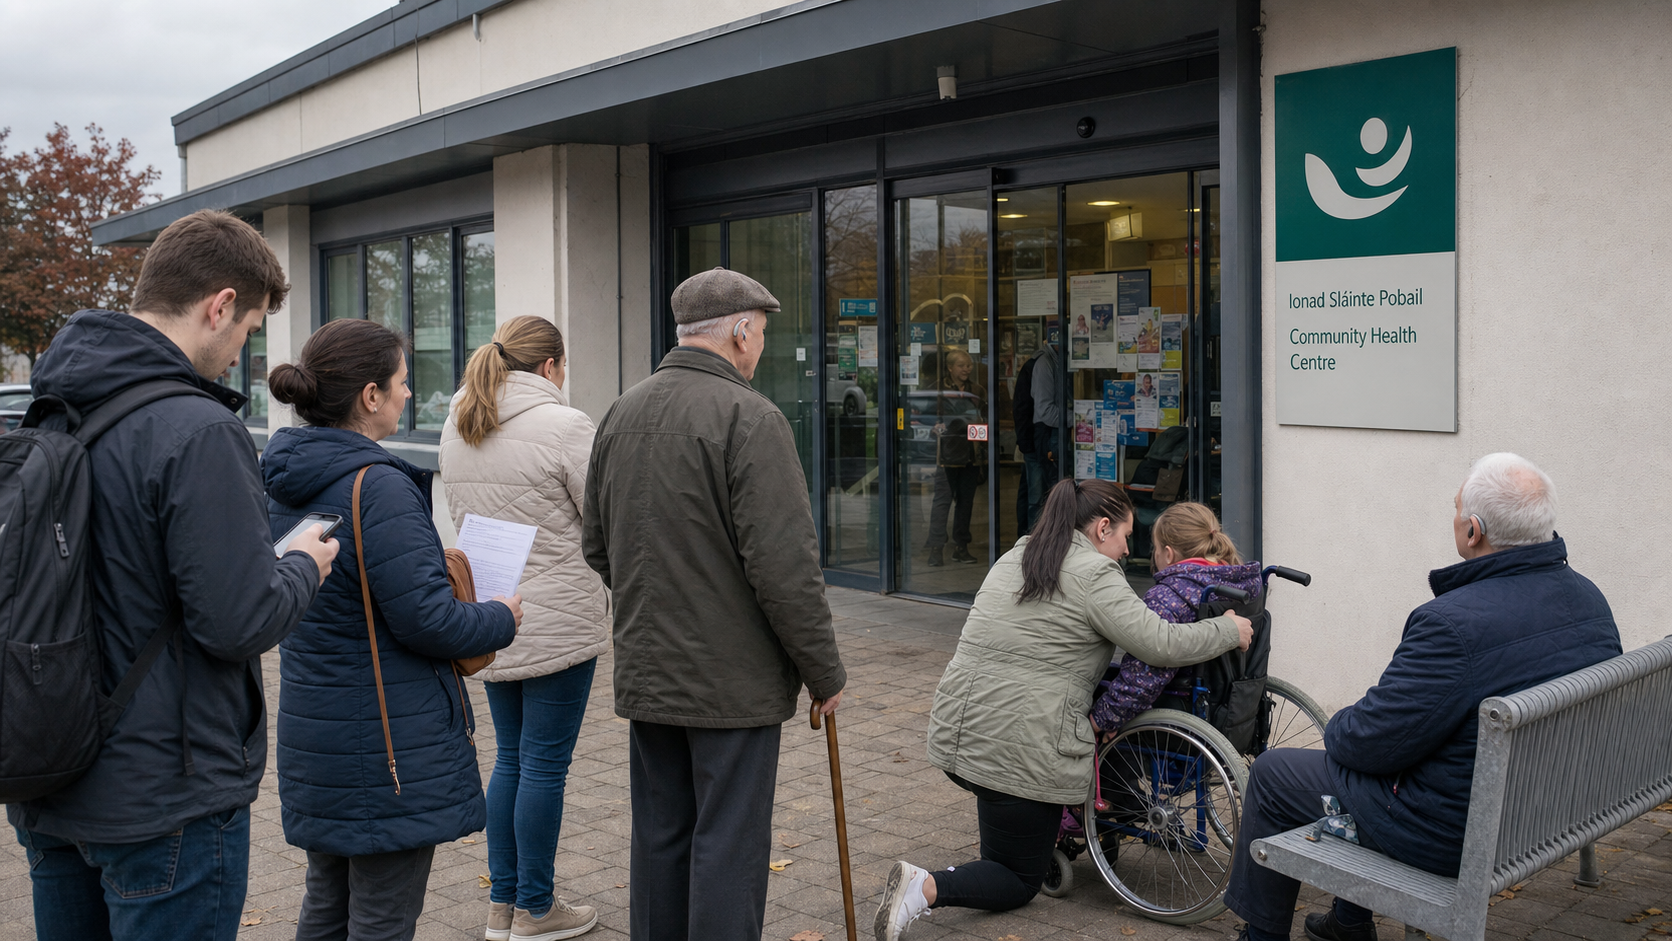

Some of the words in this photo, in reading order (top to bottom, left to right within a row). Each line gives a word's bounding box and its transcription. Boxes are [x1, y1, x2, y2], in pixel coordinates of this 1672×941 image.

[1289, 291, 1326, 309] Ionad
[1329, 290, 1375, 308] Sláinte
[1379, 287, 1423, 306] Pobail
[1289, 328, 1367, 348] Community
[1371, 326, 1417, 344] Health
[1290, 353, 1336, 371] Centre
